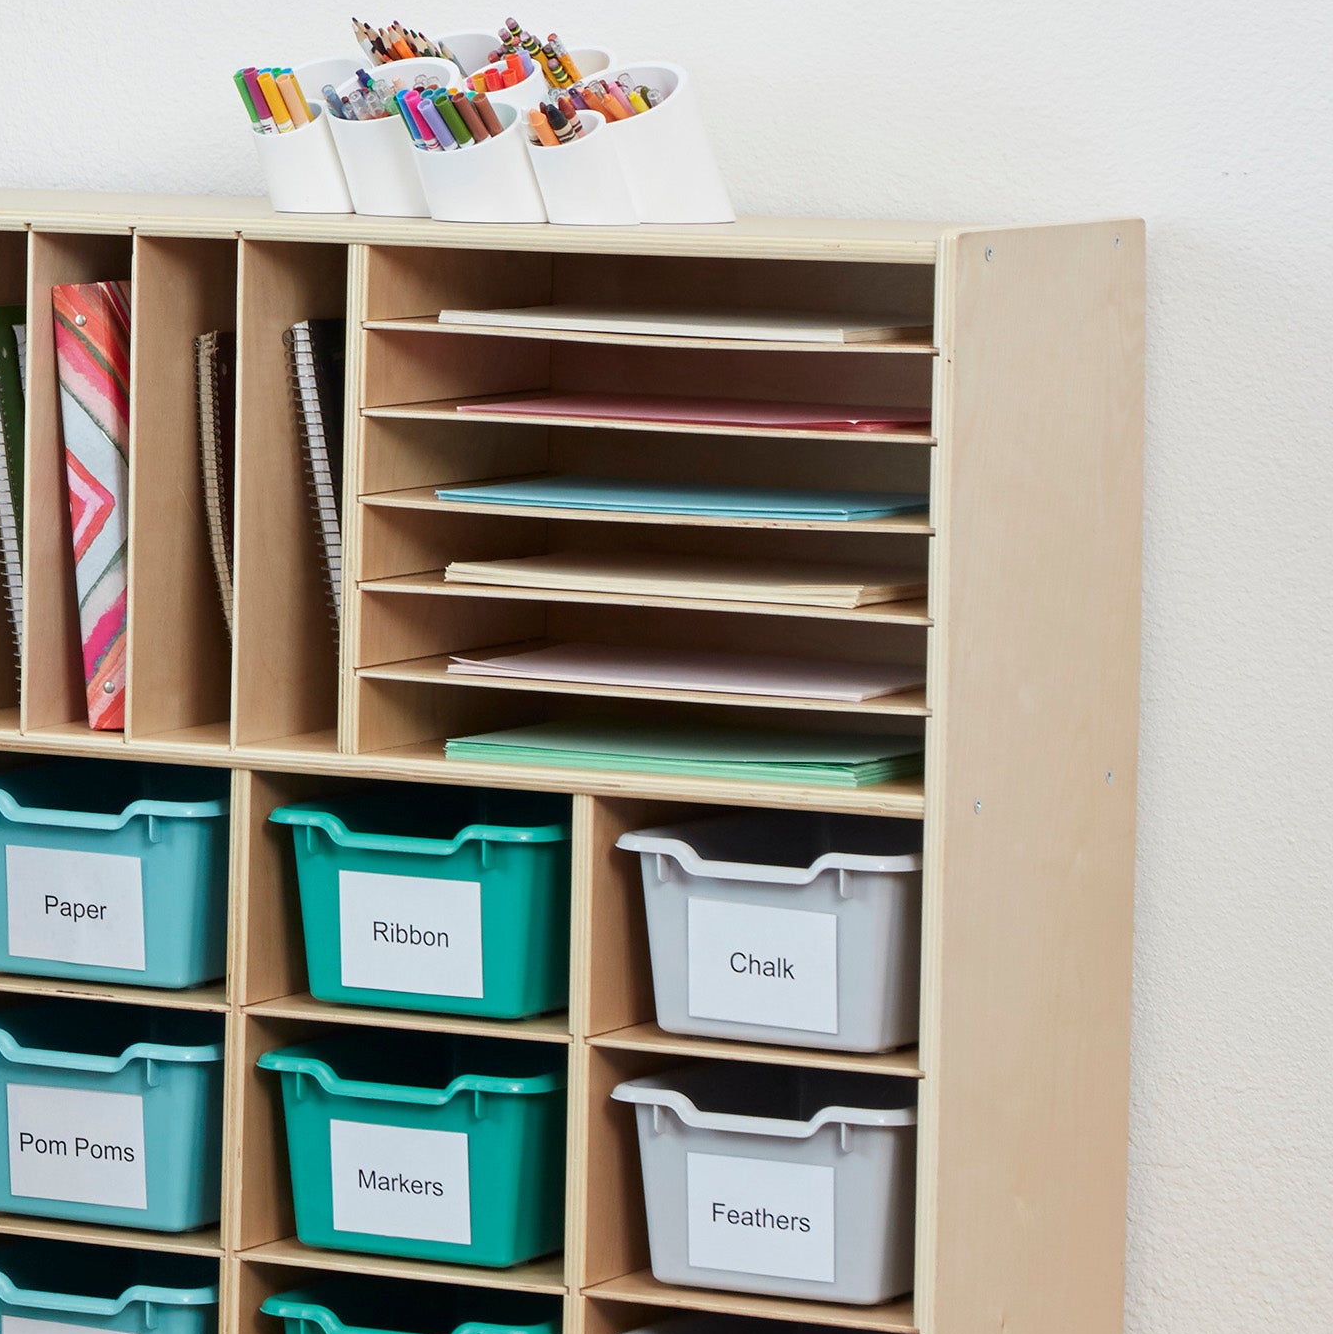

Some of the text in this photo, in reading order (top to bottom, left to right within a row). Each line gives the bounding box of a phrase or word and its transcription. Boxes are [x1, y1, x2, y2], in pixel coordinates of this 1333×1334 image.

[44, 894, 107, 923] Paper
[373, 920, 449, 948] Ribbon
[730, 952, 795, 980] Chalk
[19, 1132, 135, 1163] Pom Poms
[358, 1168, 444, 1197] Markers
[712, 1202, 811, 1233] Feathers
